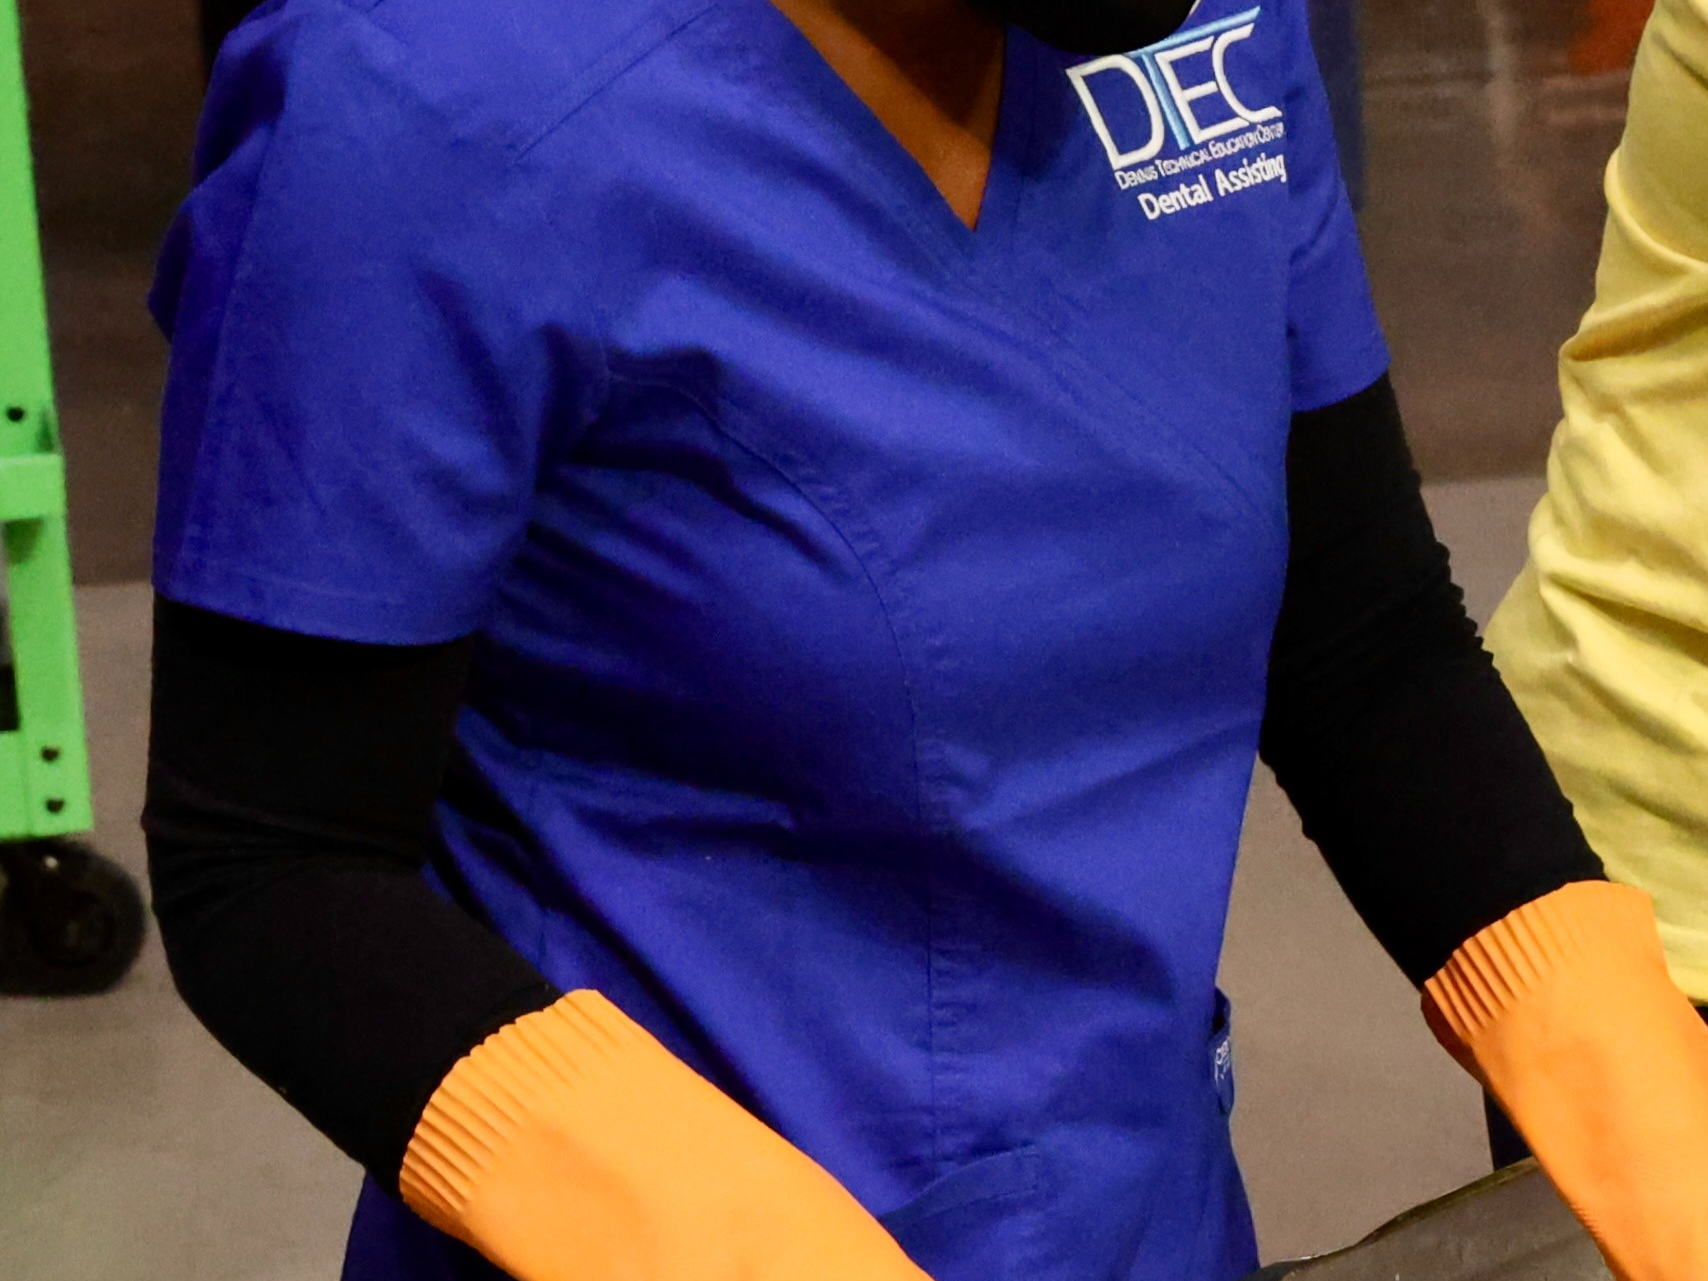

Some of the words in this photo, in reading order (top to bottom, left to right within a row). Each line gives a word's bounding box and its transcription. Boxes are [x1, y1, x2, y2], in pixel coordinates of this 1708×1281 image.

[1065, 5, 1283, 171] DTEC
[1137, 174, 1214, 221] Dental
[1214, 152, 1288, 198] Assisting
